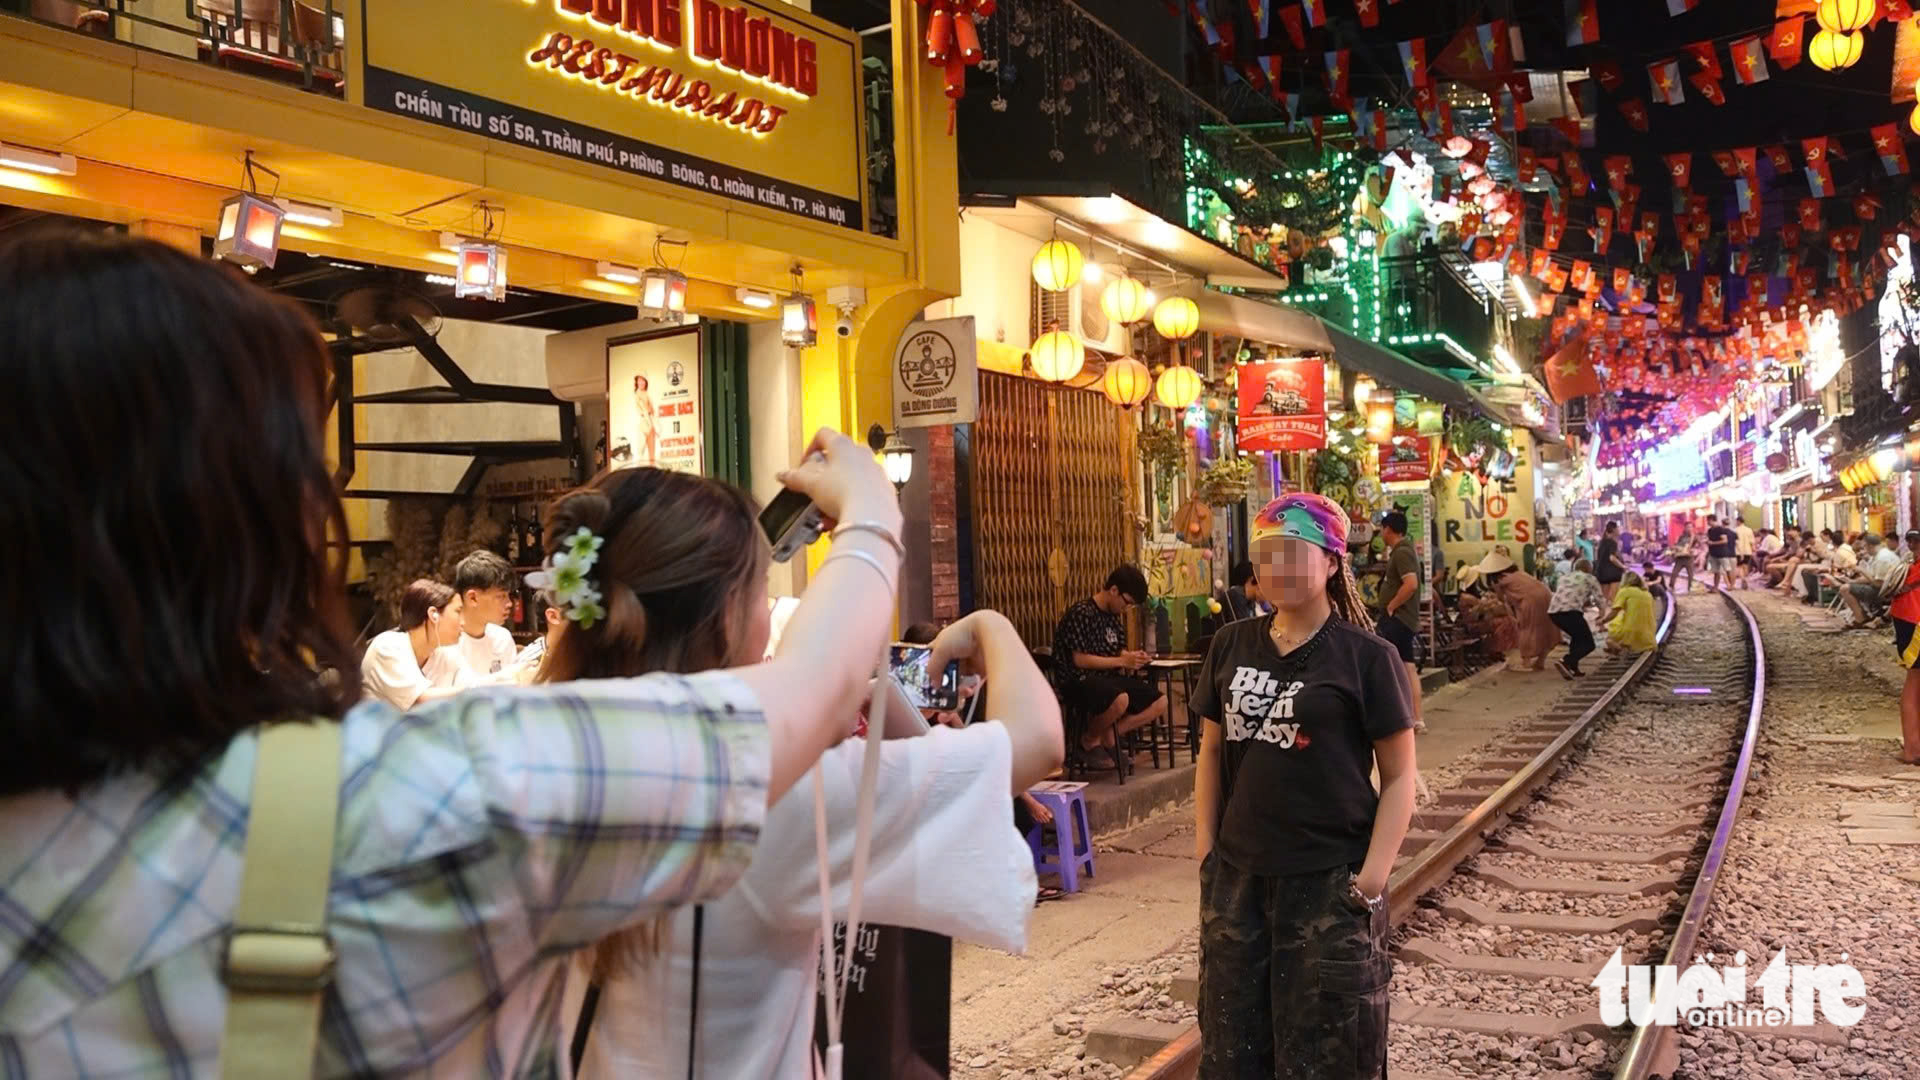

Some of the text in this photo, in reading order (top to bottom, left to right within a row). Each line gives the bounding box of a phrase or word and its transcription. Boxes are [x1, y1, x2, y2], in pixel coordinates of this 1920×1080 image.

[530, 32, 788, 133] RESTAURANT
[448, 102, 482, 129] TÀU
[489, 115, 514, 136] SỐ
[514, 122, 540, 146] 5A,
[542, 128, 582, 155] TRẦN
[710, 175, 722, 191] Q.
[724, 177, 754, 199] HOÀN
[791, 196, 809, 213] TP.
[812, 200, 826, 218] HÀ
[1241, 420, 1290, 437] RAILWAY
[1457, 472, 1517, 497] AE
[1464, 495, 1508, 520] NO
[1445, 519, 1530, 543] RULES
[1229, 666, 1304, 699] Blue
[1225, 690, 1295, 719] Jean
[1225, 712, 1300, 749] Baby
